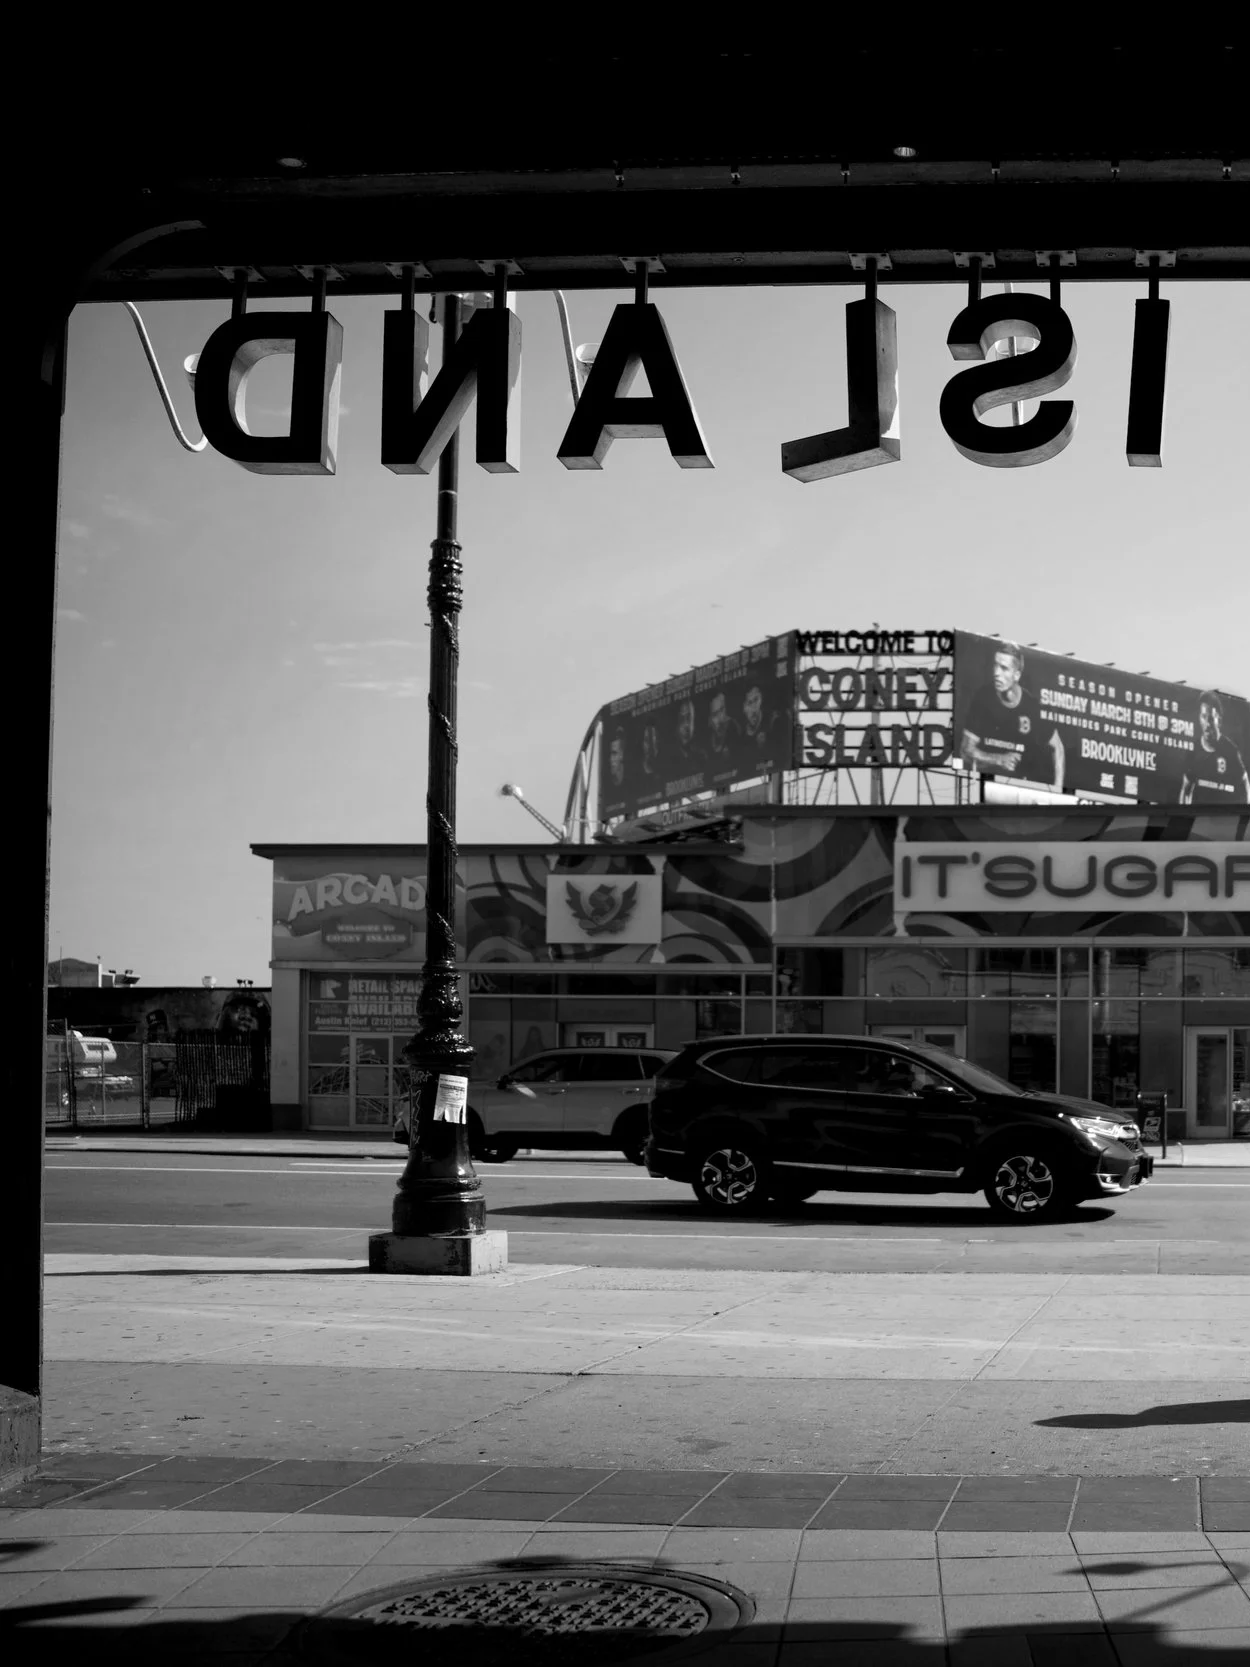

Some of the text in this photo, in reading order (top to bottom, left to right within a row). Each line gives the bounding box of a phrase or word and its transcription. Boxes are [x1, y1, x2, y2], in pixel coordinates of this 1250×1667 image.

[797, 630, 953, 654] WELCOME TO
[800, 667, 950, 710] CONEY
[1058, 673, 1179, 713] SEASON OPENER
[1040, 688, 1088, 713] SUNDAY
[1090, 699, 1131, 724] MARCH
[1170, 718, 1194, 738] 3PM
[794, 723, 953, 766] ISLAND
[1104, 723, 1127, 737] PARK
[1131, 730, 1160, 744] CONEY
[1164, 736, 1195, 752] ISLAND
[288, 874, 428, 920] ARCAD
[346, 994, 420, 1015] AVAILAB
[390, 979, 424, 994] SPAC
